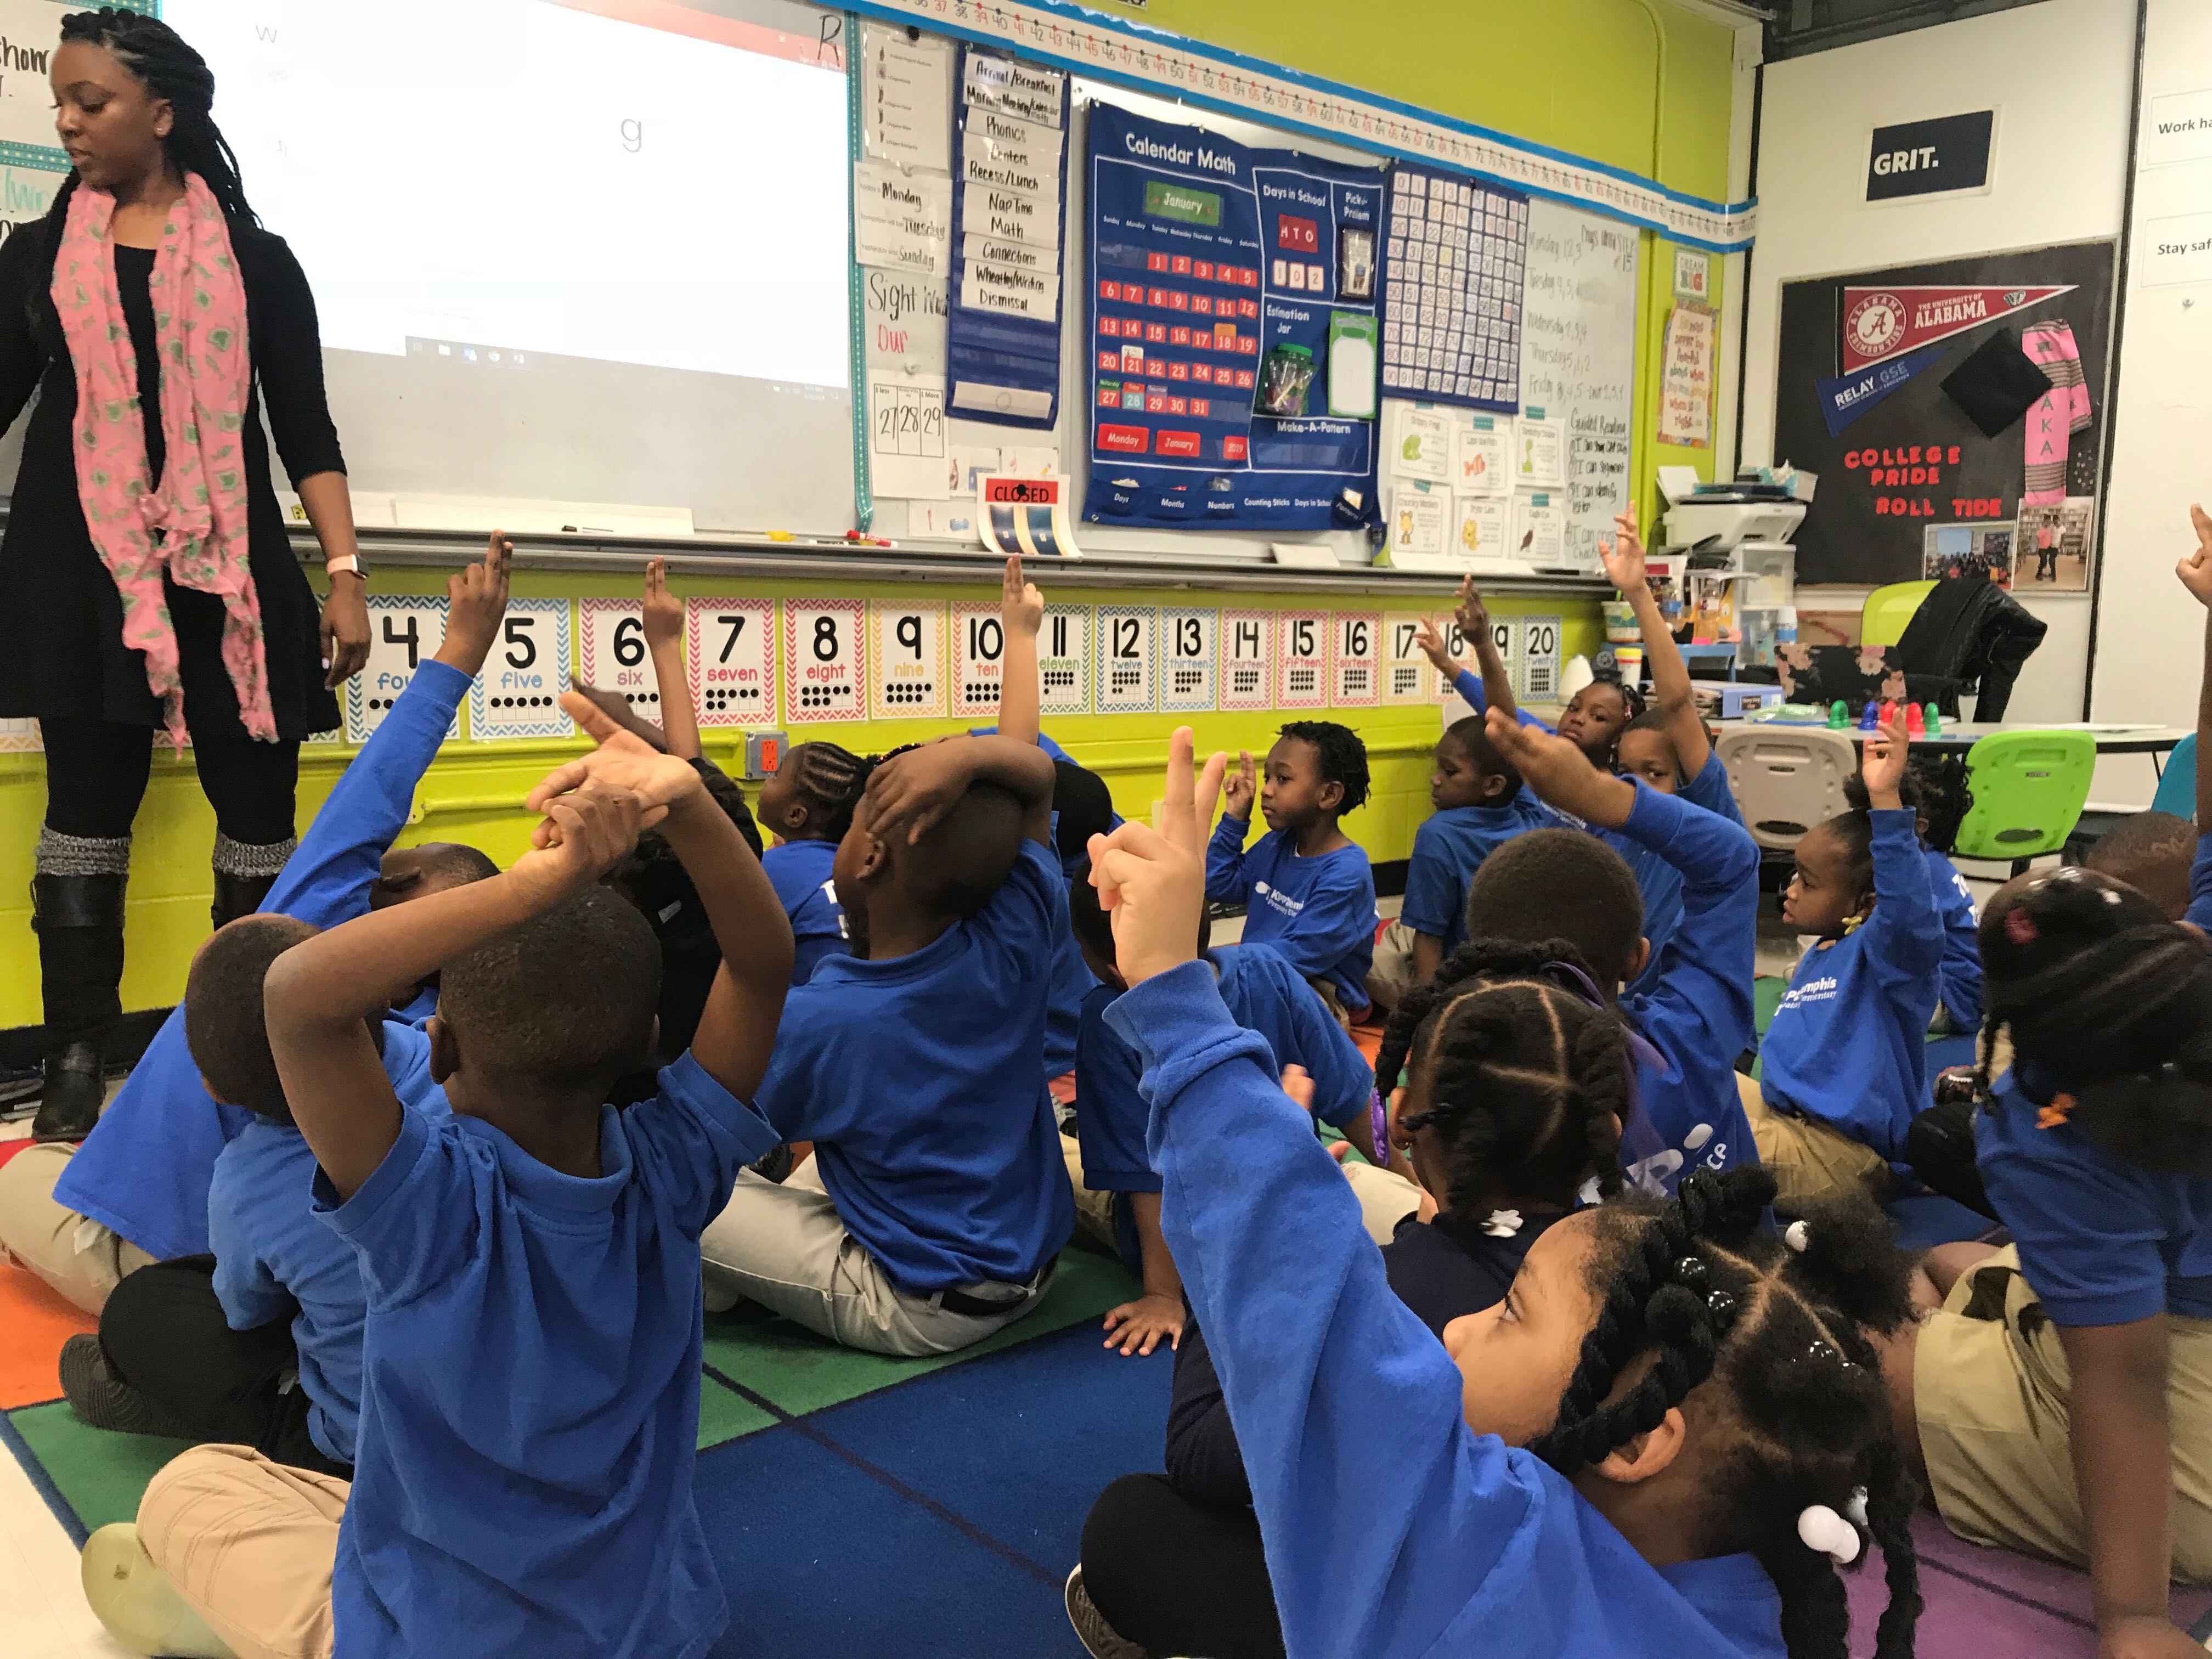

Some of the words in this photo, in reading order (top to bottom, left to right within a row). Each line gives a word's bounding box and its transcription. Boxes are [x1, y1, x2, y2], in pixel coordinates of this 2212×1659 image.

[992, 14, 1008, 30] 40
[1014, 22, 1024, 36] 41
[1030, 26, 1044, 41] 42
[817, 15, 842, 67] R
[621, 119, 641, 153] g
[986, 115, 1026, 143] Phonics
[2158, 120, 2194, 134] Work
[991, 144, 1028, 166] Centers
[1126, 132, 1194, 165] Calendar
[1198, 147, 1235, 175] Math
[1874, 146, 1939, 176] GRIT.
[970, 160, 1038, 191] Recess/Lunch
[882, 181, 922, 212] Monday
[989, 193, 1012, 213] Nap
[1013, 198, 1032, 215] Time
[1164, 193, 1202, 215] January
[1263, 184, 1286, 200] Days
[1289, 189, 1295, 199] in
[1298, 190, 1325, 207] School
[902, 217, 945, 241] Tuesday
[991, 216, 1023, 240] Math
[1280, 224, 1288, 238] H
[1293, 228, 1299, 240] T
[899, 245, 934, 272] Sunday
[983, 242, 1036, 265] Connections
[1528, 231, 1559, 263] Monday
[2158, 244, 2187, 255] Stay
[1155, 256, 1160, 268] 1
[1179, 259, 1184, 271] 2
[1200, 263, 1206, 276] 3
[1224, 269, 1230, 280] 4
[1245, 271, 1251, 283] 5
[1622, 255, 1632, 272] 15
[1680, 256, 1704, 273] DREAM
[1312, 273, 1318, 284] 2
[868, 273, 917, 321] Sight
[980, 288, 1028, 311] Dismissal
[1107, 284, 1114, 297] 6
[1130, 288, 1136, 300] 7
[1155, 291, 1161, 304] 8
[1176, 296, 1181, 308] 9
[1195, 298, 1207, 311] 10
[1221, 303, 1232, 314] 11
[1242, 303, 1254, 316] 12
[1932, 296, 1972, 307] UNIVERSITY
[1267, 305, 1310, 321] Estimation
[1852, 296, 1903, 325] ALABAMA
[1915, 300, 1987, 329] ALABAMA
[1104, 320, 1116, 333] 13
[1126, 323, 1137, 335] 14
[1150, 326, 1162, 340] 15
[1175, 330, 1187, 342] 16
[1196, 334, 1207, 346] 17
[1220, 336, 1231, 349] 18
[1241, 338, 1252, 351] 19
[1277, 324, 1291, 334] Jar
[1863, 311, 1886, 338] A
[878, 323, 907, 353] Our
[1103, 355, 1115, 367] 20
[1128, 360, 1139, 372] 21
[1150, 363, 1161, 375] 22
[1172, 365, 1184, 378] 23
[1196, 366, 1207, 378] 24
[1218, 370, 1229, 383] 25
[1239, 374, 1250, 385] 26
[1835, 376, 1874, 407] RELAY
[1880, 361, 1908, 382] GSE
[1103, 392, 1116, 404] 27
[1127, 395, 1139, 407] 28
[1150, 399, 1162, 410] 29
[1171, 400, 1183, 411] 30
[1194, 402, 1204, 414] 31
[880, 408, 898, 440] 27
[900, 405, 918, 432] 28
[924, 407, 941, 436] 29
[1277, 422, 1351, 435] Make-A-Pattern
[1108, 433, 1139, 447] Monday
[1165, 438, 1193, 452] January
[1228, 444, 1243, 453] 2019
[1844, 445, 1960, 469] COLLEGE
[1871, 467, 1939, 486] PRIDE
[995, 486, 1049, 503] CLOSED
[1114, 494, 1129, 504] Days
[1161, 498, 1184, 509] Months
[1207, 500, 1234, 510] Numbers
[1244, 498, 1271, 507] Counting
[1273, 498, 1290, 506] Sticks
[1295, 499, 1309, 507] Days
[1876, 497, 1935, 516] ROLL
[1952, 498, 2002, 517] TIDE
[383, 616, 419, 669] 4
[505, 618, 535, 669] 5
[614, 618, 644, 666] 6
[718, 616, 745, 663] 7
[814, 616, 838, 662] 8
[897, 616, 921, 659] 9
[970, 617, 1003, 661] 10
[1053, 616, 1066, 657] 11
[1113, 618, 1139, 658] 12
[1176, 618, 1201, 656] 13
[1236, 622, 1259, 658] 14
[1293, 620, 1314, 656] 15
[1346, 621, 1367, 656] 16
[1397, 624, 1417, 658] 17
[1446, 624, 1463, 657] 18
[1528, 626, 1554, 654] 20
[707, 667, 758, 682] seven
[806, 663, 845, 682] eight
[894, 662, 924, 678] nine
[976, 663, 999, 677] ten
[1039, 656, 1080, 670] eleven
[1110, 659, 1142, 669] twelve
[1169, 659, 1209, 670] thirteen
[1229, 659, 1265, 669] fourteen
[1285, 658, 1321, 668] fifteen
[1340, 658, 1372, 668] sixteen
[500, 672, 543, 690] five
[617, 671, 643, 686] six
